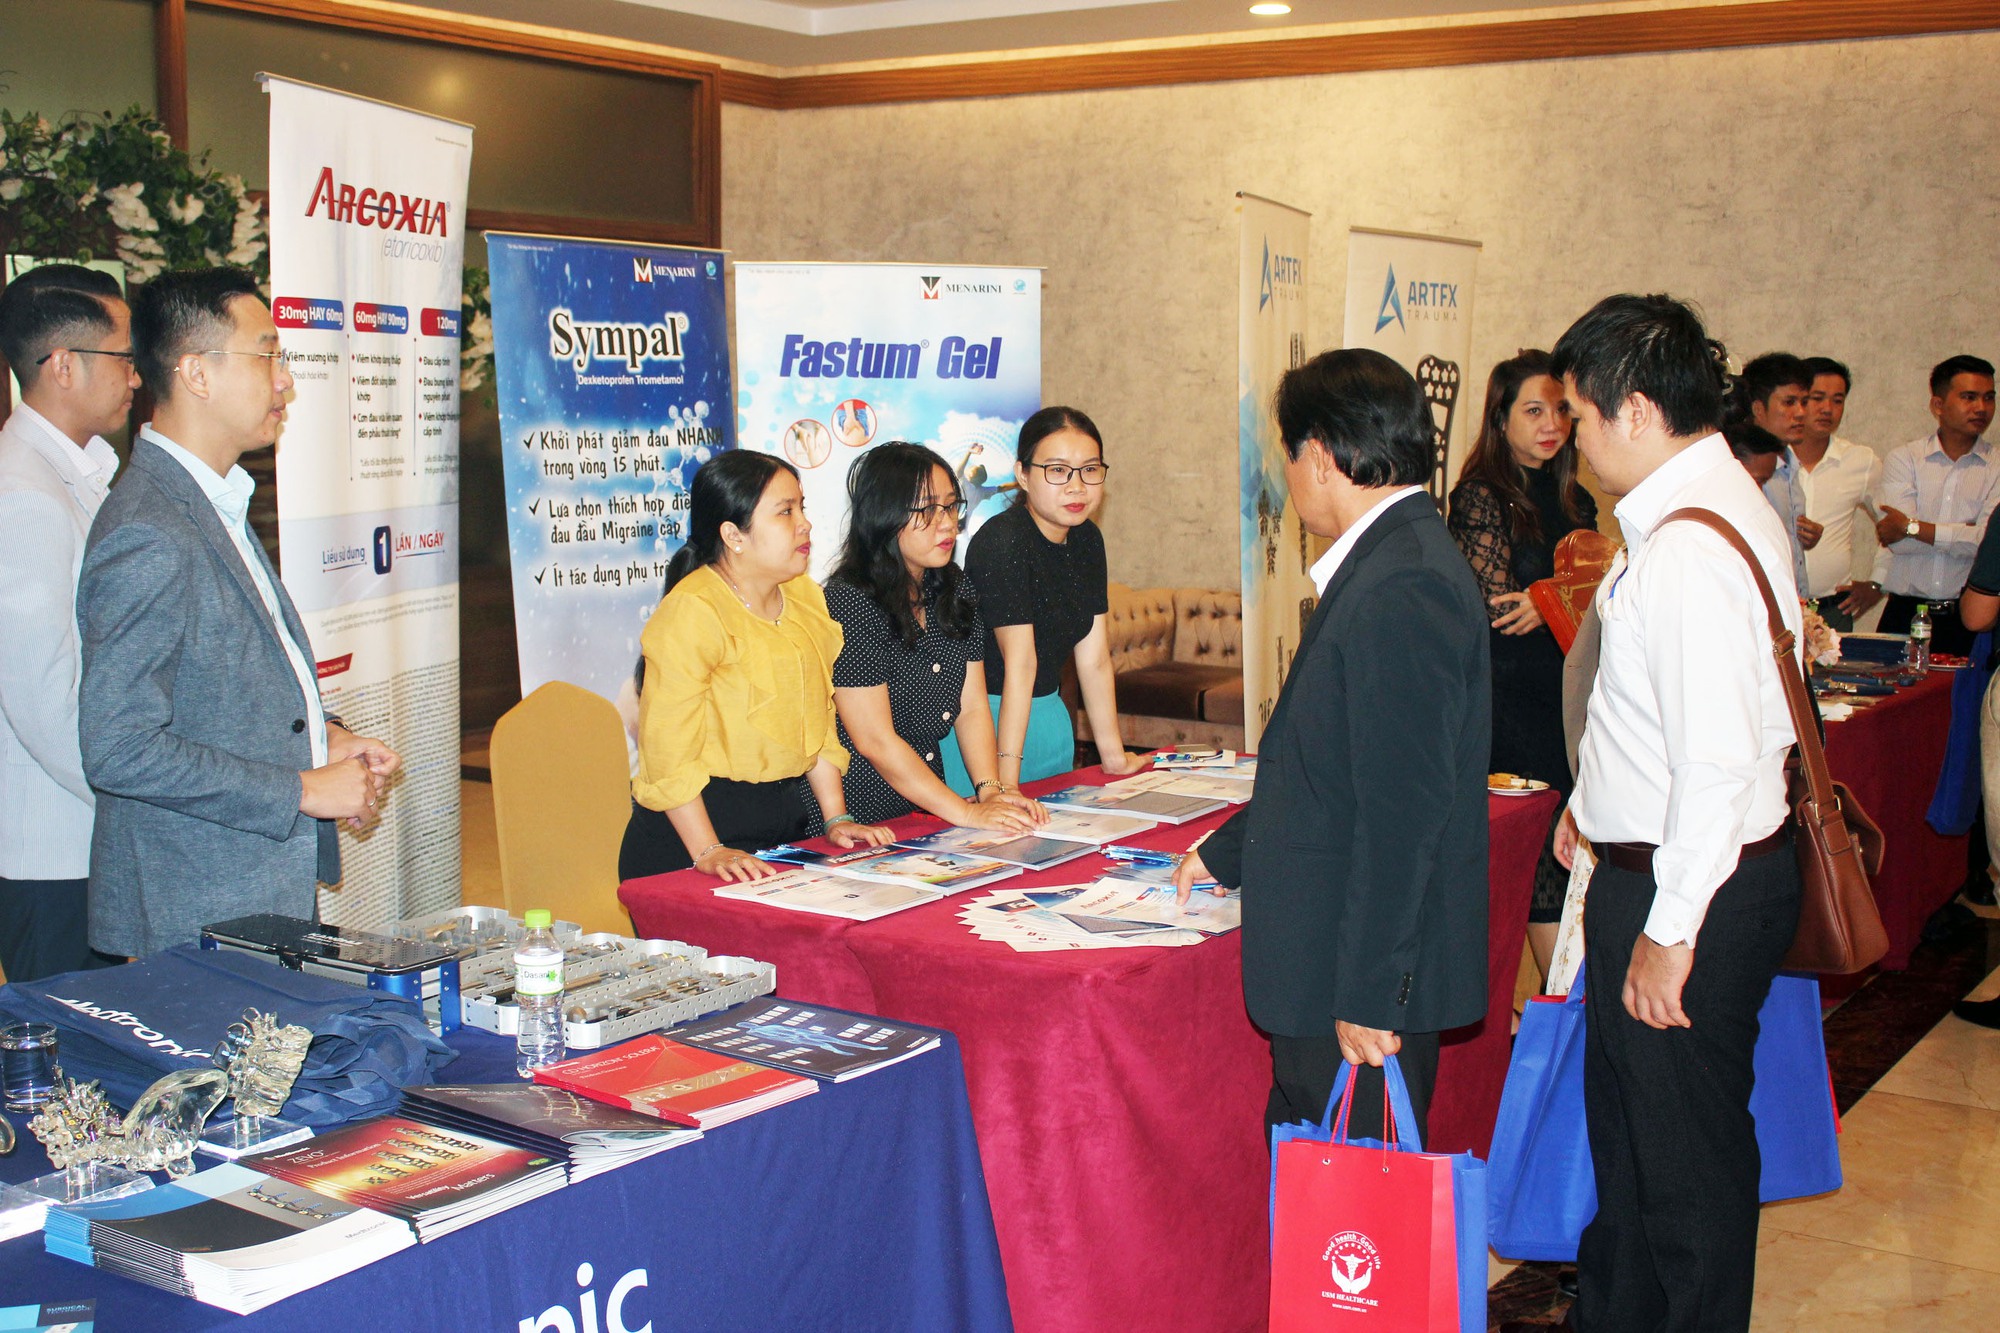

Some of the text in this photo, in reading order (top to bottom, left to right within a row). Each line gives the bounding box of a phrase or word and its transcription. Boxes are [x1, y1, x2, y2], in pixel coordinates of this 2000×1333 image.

[653, 265, 696, 278] MENARINI
[945, 283, 1002, 295] MENARINI
[1407, 281, 1458, 308] ARTFX
[279, 305, 343, 326] 30mg HAY 60mg
[355, 311, 377, 329] 60mg
[387, 312, 407, 329] 90mg
[436, 316, 457, 333] 120mg
[1407, 309, 1458, 322] TRAUMA
[936, 336, 1003, 380] Gel
[578, 374, 684, 386] Dexketoprofen Trometamol
[540, 427, 724, 454] Khởi phát giảm đau NHANH
[544, 453, 665, 480] trong vòng 15 phút.
[549, 499, 569, 523] Lựa
[575, 497, 602, 520] chọn
[608, 496, 637, 515] thích
[643, 494, 664, 517] hợp
[419, 529, 445, 549] NGÀY
[551, 514, 681, 544] đau đầu Migraine cấp
[553, 562, 563, 587] Ít
[569, 566, 587, 585] tác
[593, 564, 621, 587] dụng
[627, 561, 647, 583] phụ
[451, 1173, 496, 1191] Matters
[1322, 1241, 1336, 1261] Good
[1360, 1237, 1377, 1255] Good
[1321, 1291, 1379, 1307] USM HEALTHCARE
